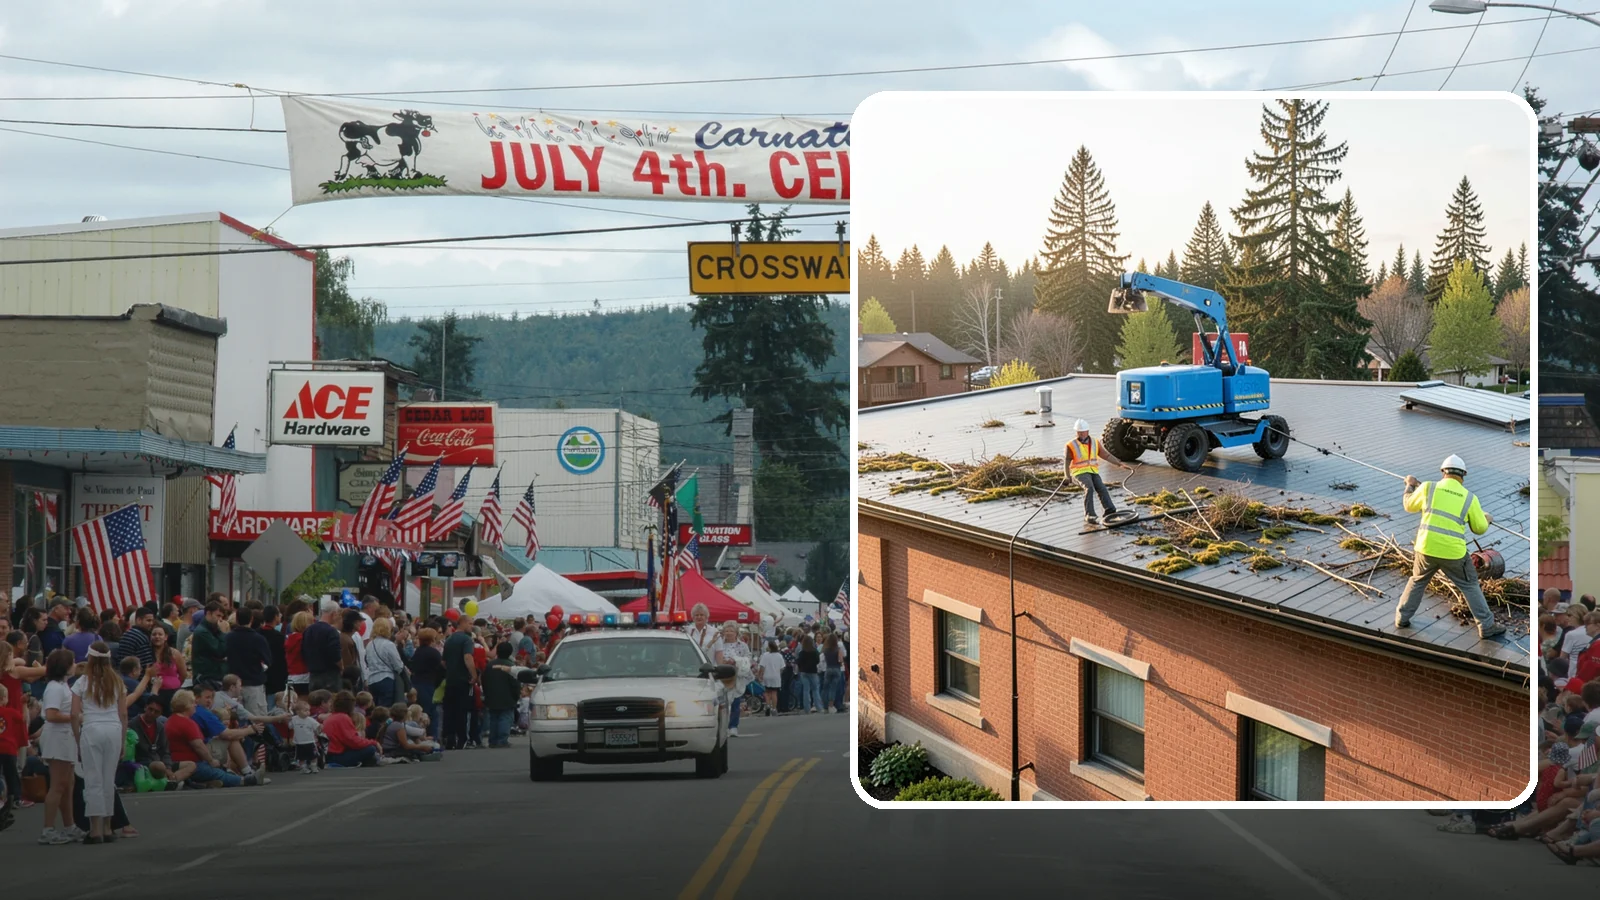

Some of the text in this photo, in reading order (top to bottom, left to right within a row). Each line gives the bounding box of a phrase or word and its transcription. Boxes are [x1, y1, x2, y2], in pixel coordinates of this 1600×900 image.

[695, 122, 850, 149] Carnat
[481, 141, 605, 193] JULY
[633, 150, 747, 198] 4th.
[697, 254, 850, 280] CROSSWA
[283, 380, 373, 420] ACE
[405, 408, 485, 422] CEDAR LOG
[283, 420, 371, 436] Hardware
[353, 467, 386, 479] Simpl
[95, 484, 124, 495] Vincent
[126, 486, 136, 495] de
[137, 485, 156, 496] Paul
[688, 526, 742, 535] CRNATION
[699, 535, 730, 543] GLASS
